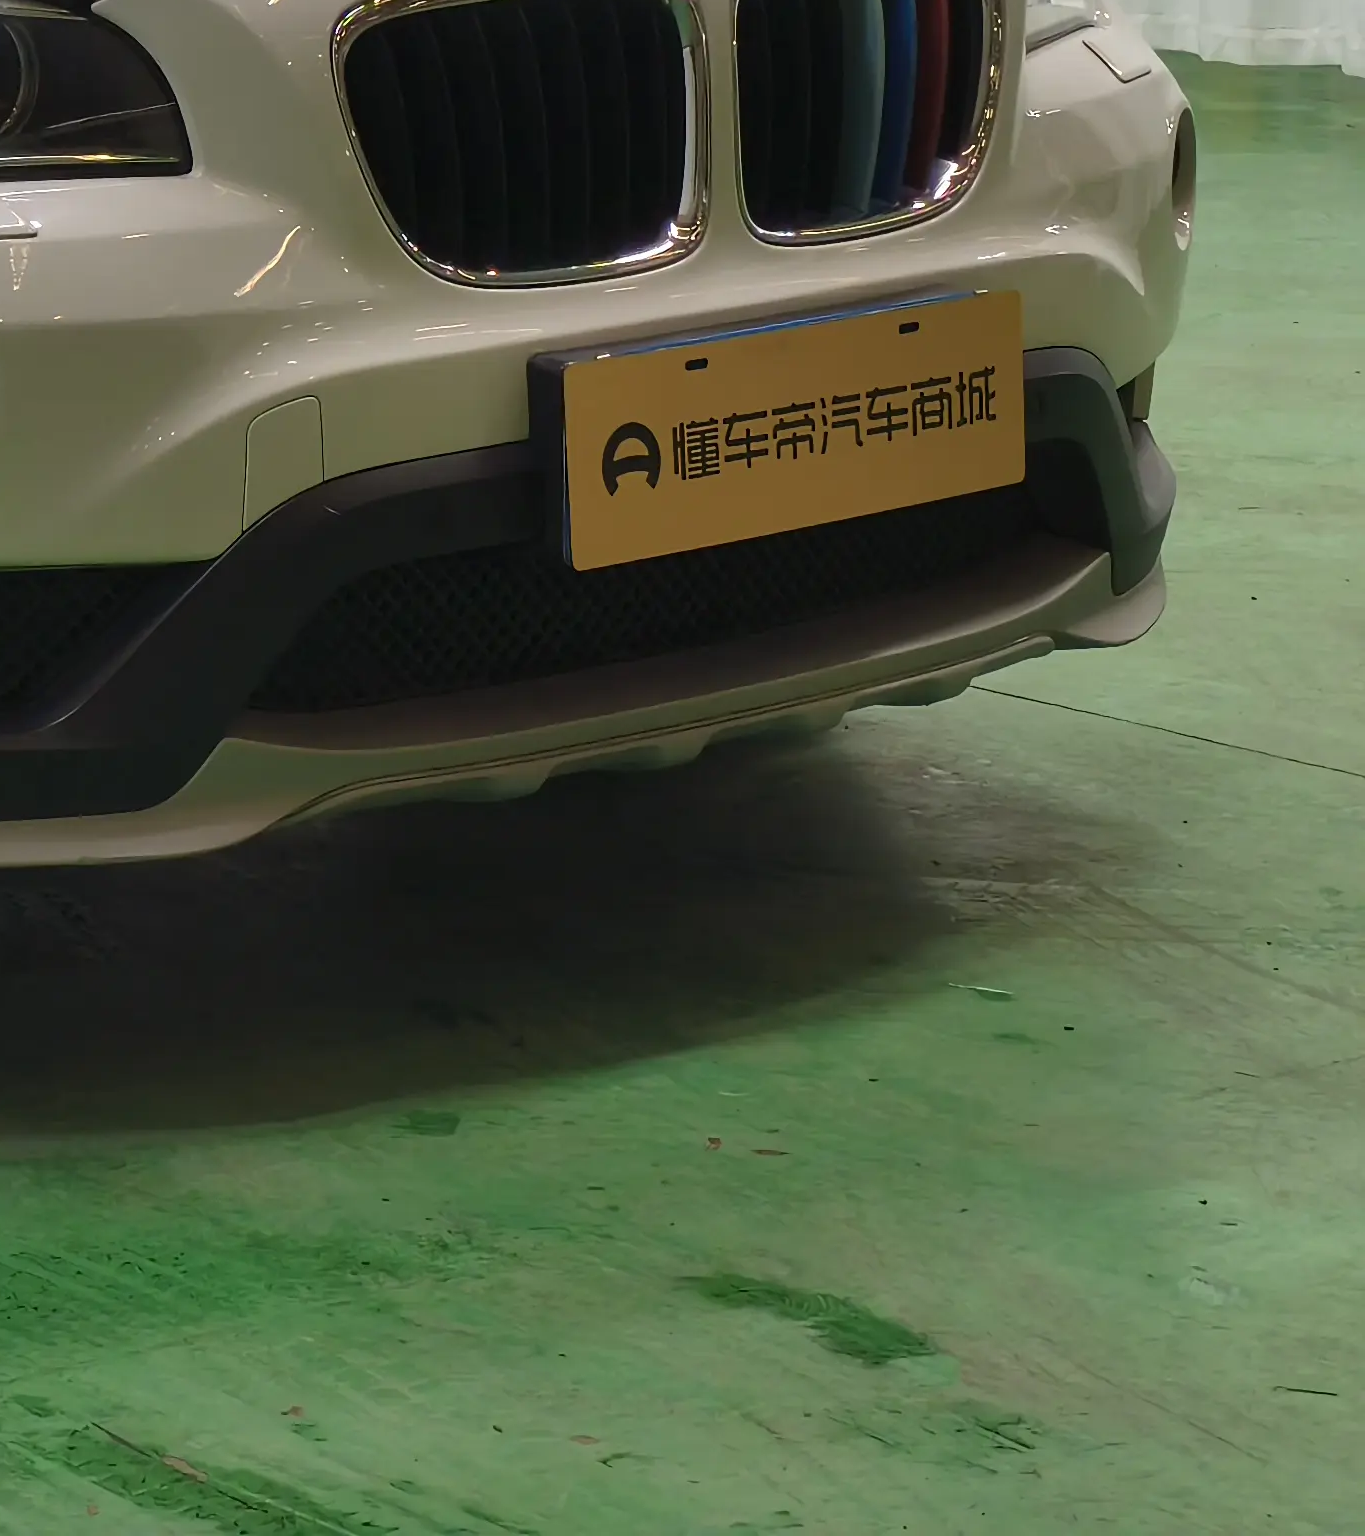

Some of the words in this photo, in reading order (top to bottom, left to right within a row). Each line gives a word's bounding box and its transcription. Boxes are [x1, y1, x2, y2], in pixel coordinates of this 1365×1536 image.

[672, 365, 997, 480] 懂车帝汽车商城
